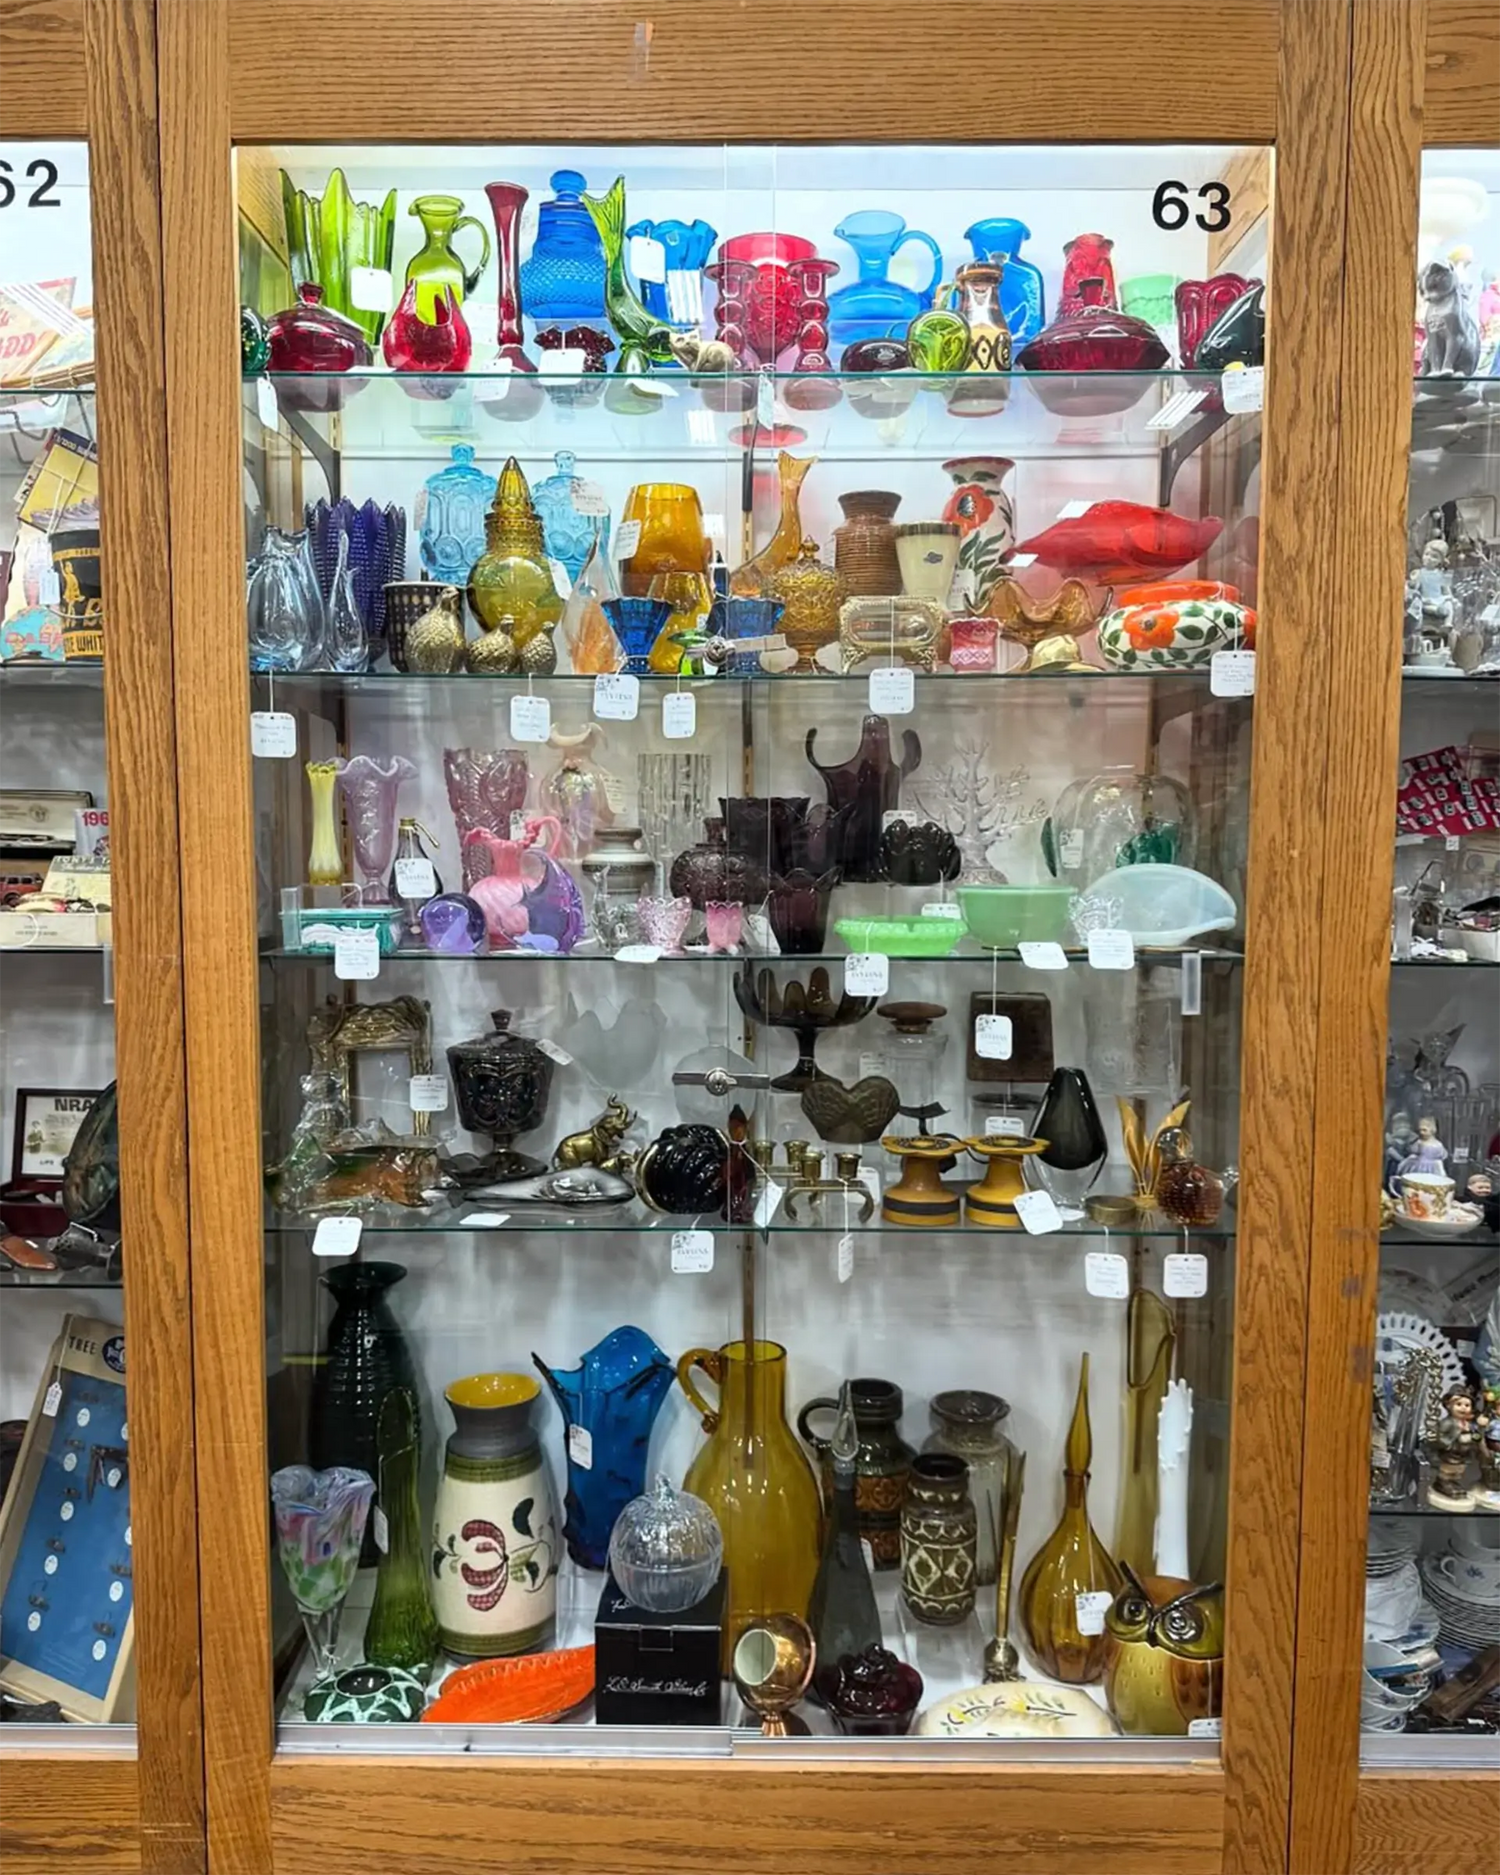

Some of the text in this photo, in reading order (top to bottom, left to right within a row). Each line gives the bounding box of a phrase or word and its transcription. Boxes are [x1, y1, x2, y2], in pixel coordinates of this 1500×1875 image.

[1152, 180, 1231, 232] 63
[54, 1098, 95, 1112] NRA
[69, 1335, 96, 1355] TREE
